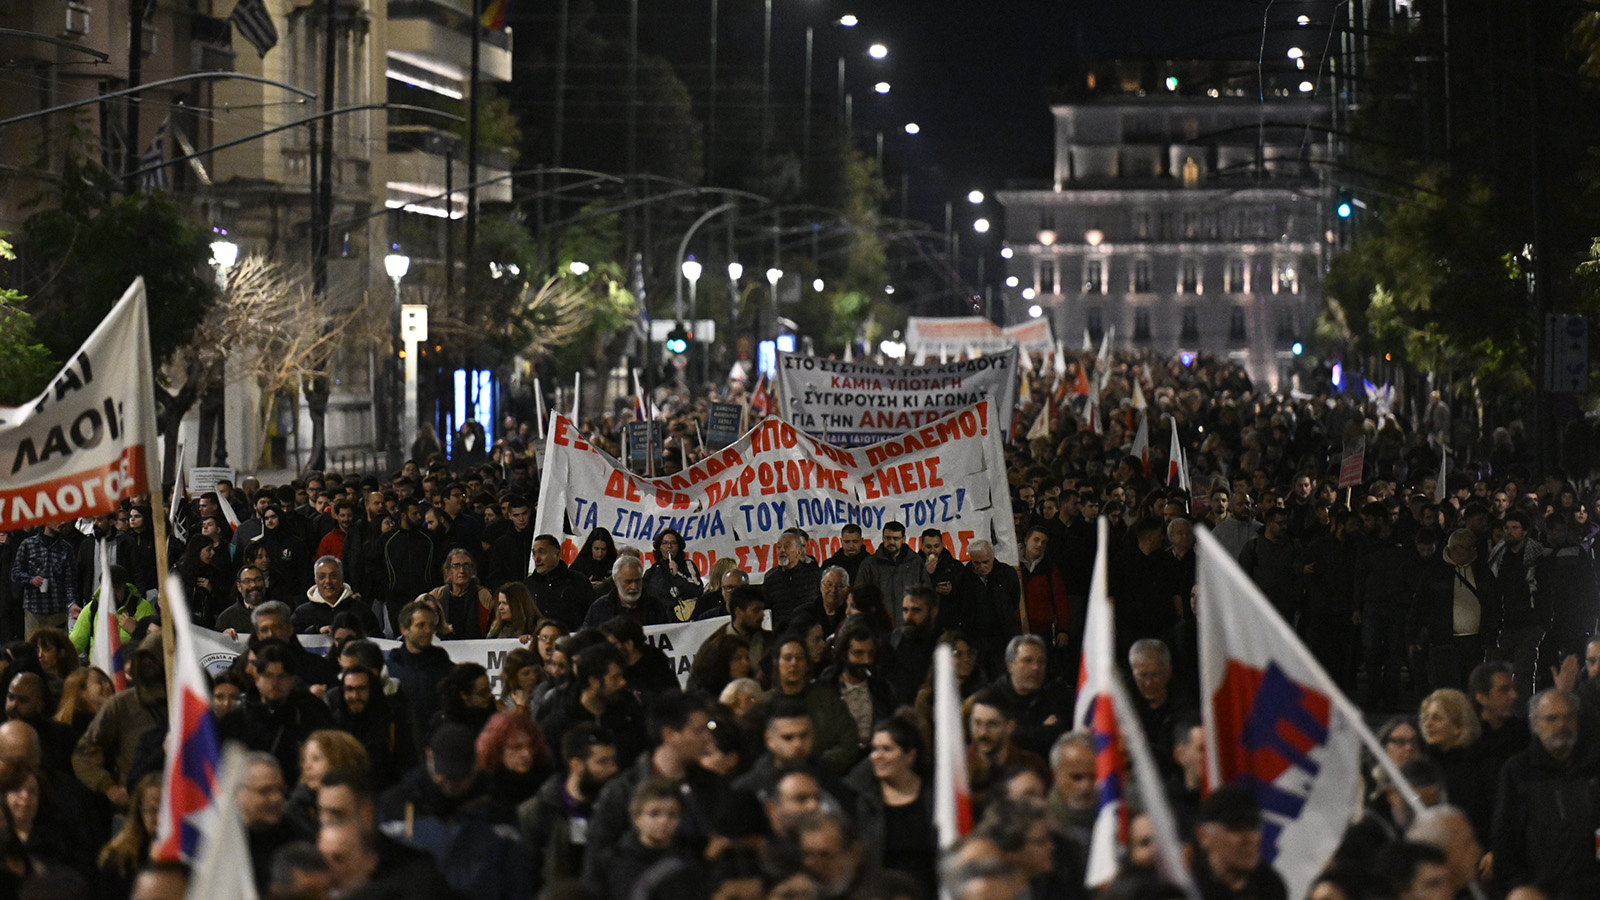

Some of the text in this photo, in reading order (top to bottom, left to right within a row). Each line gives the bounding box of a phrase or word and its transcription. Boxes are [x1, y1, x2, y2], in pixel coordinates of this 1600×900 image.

[35, 350, 93, 413] ΑΙ
[784, 356, 815, 371] ΣΤΟ
[831, 376, 962, 391] ΚΑΜΙΑ ΥΠΟΤΑΓΗ
[792, 409, 957, 429] ΓΙΑ ΤΗΝ ΑΝΑΤΡ
[804, 391, 898, 408] ΣΥΓΚΡΟΥΣΗ
[903, 395, 918, 408] ΚΙ
[10, 396, 124, 475] ΛΑΟΙ
[751, 419, 798, 457] ΑΠΟ
[865, 401, 988, 467] ΠΟΛΕΜΟ!
[862, 456, 944, 499] ΕΜΕΙΣ
[575, 488, 966, 541] ΤΑ ΣΠΑΣΜΕΝΑ ΤΟΥ ΠΟΛΕΜΟΥ ΤΟΥΣ!
